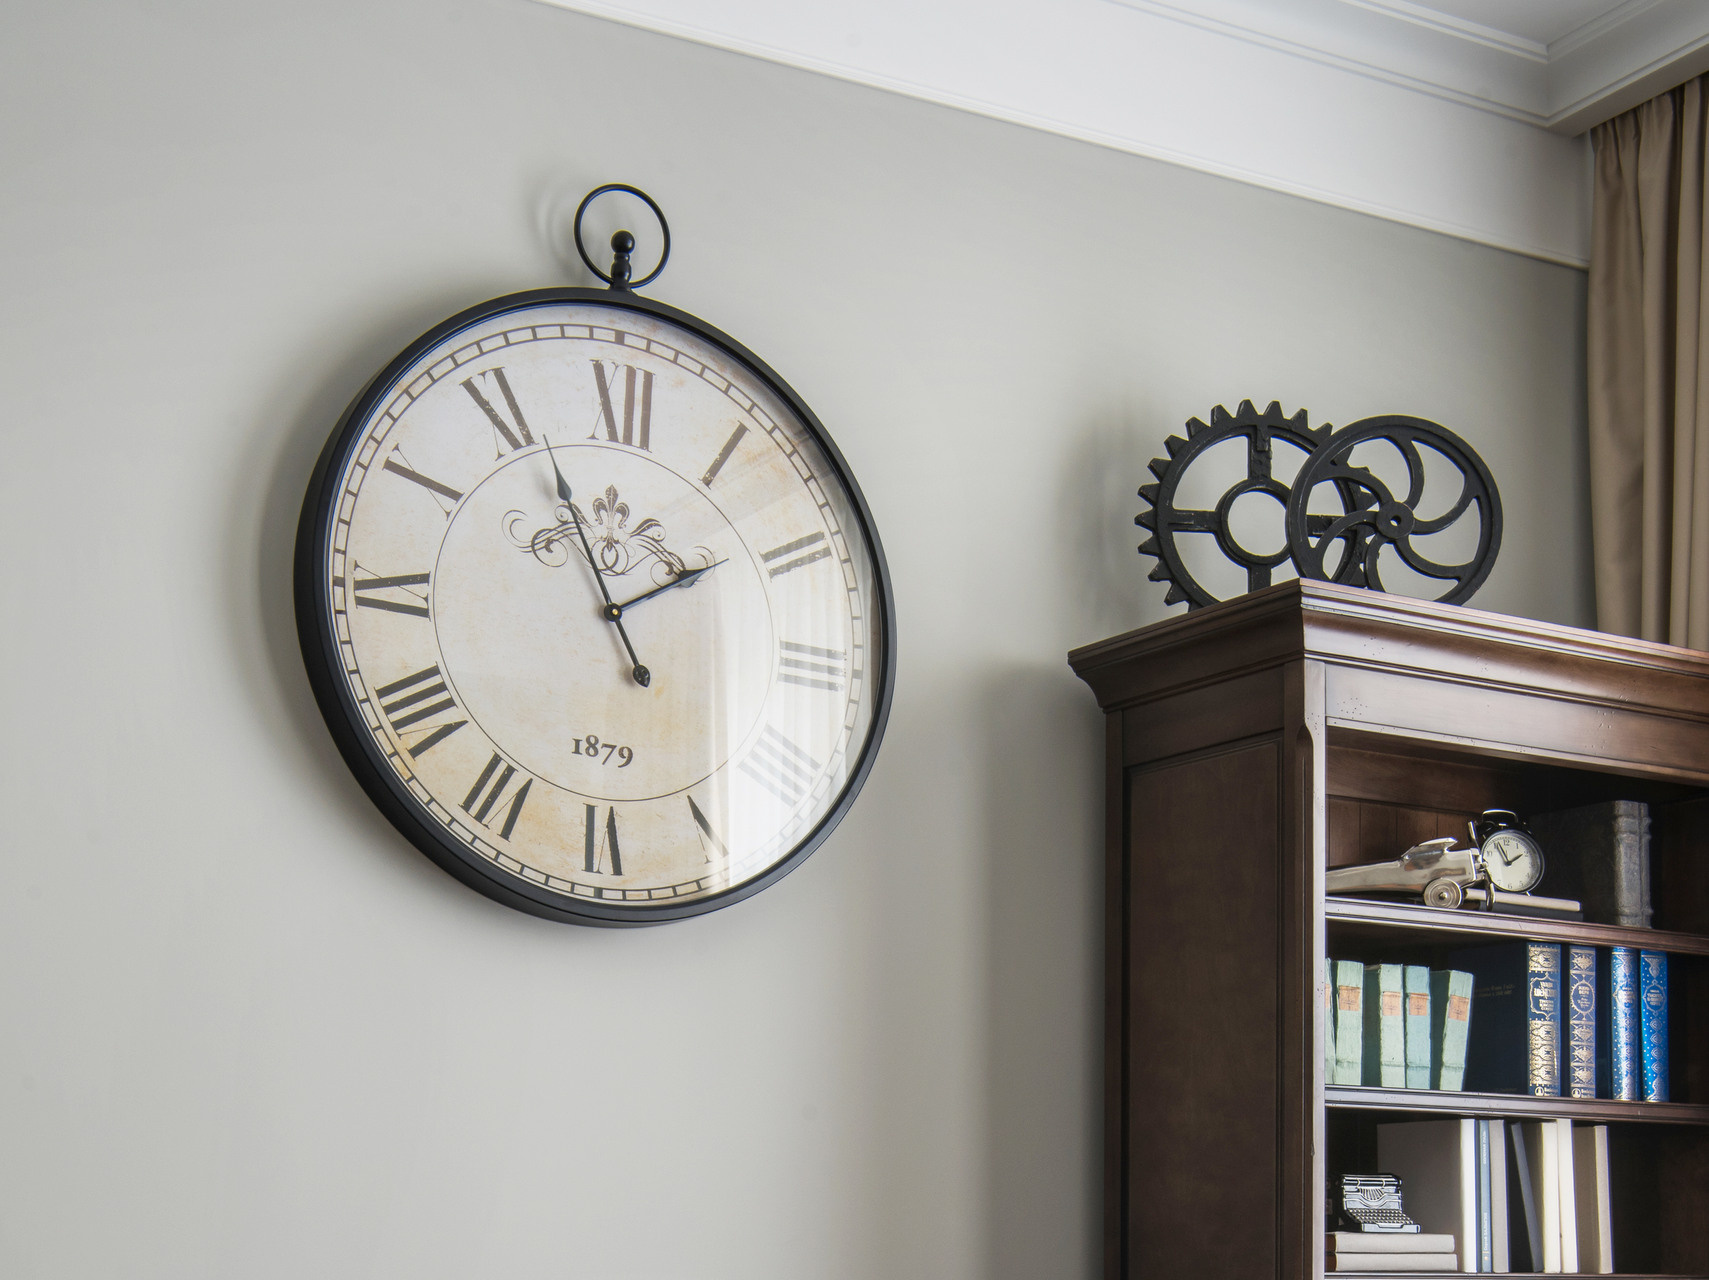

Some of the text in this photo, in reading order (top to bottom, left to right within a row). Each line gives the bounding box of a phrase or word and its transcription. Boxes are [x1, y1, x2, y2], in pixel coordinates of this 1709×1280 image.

[459, 366, 539, 461] XI
[586, 359, 656, 453] XII
[382, 442, 465, 521] X
[698, 419, 752, 490] I
[354, 559, 431, 621] IX
[758, 530, 833, 583] II
[776, 636, 847, 691] III
[373, 661, 469, 761] VIII
[571, 734, 634, 768] 1879
[458, 749, 533, 842] VII
[687, 794, 729, 864] V
[582, 803, 623, 875] VI
[1503, 839, 1511, 847] 12
